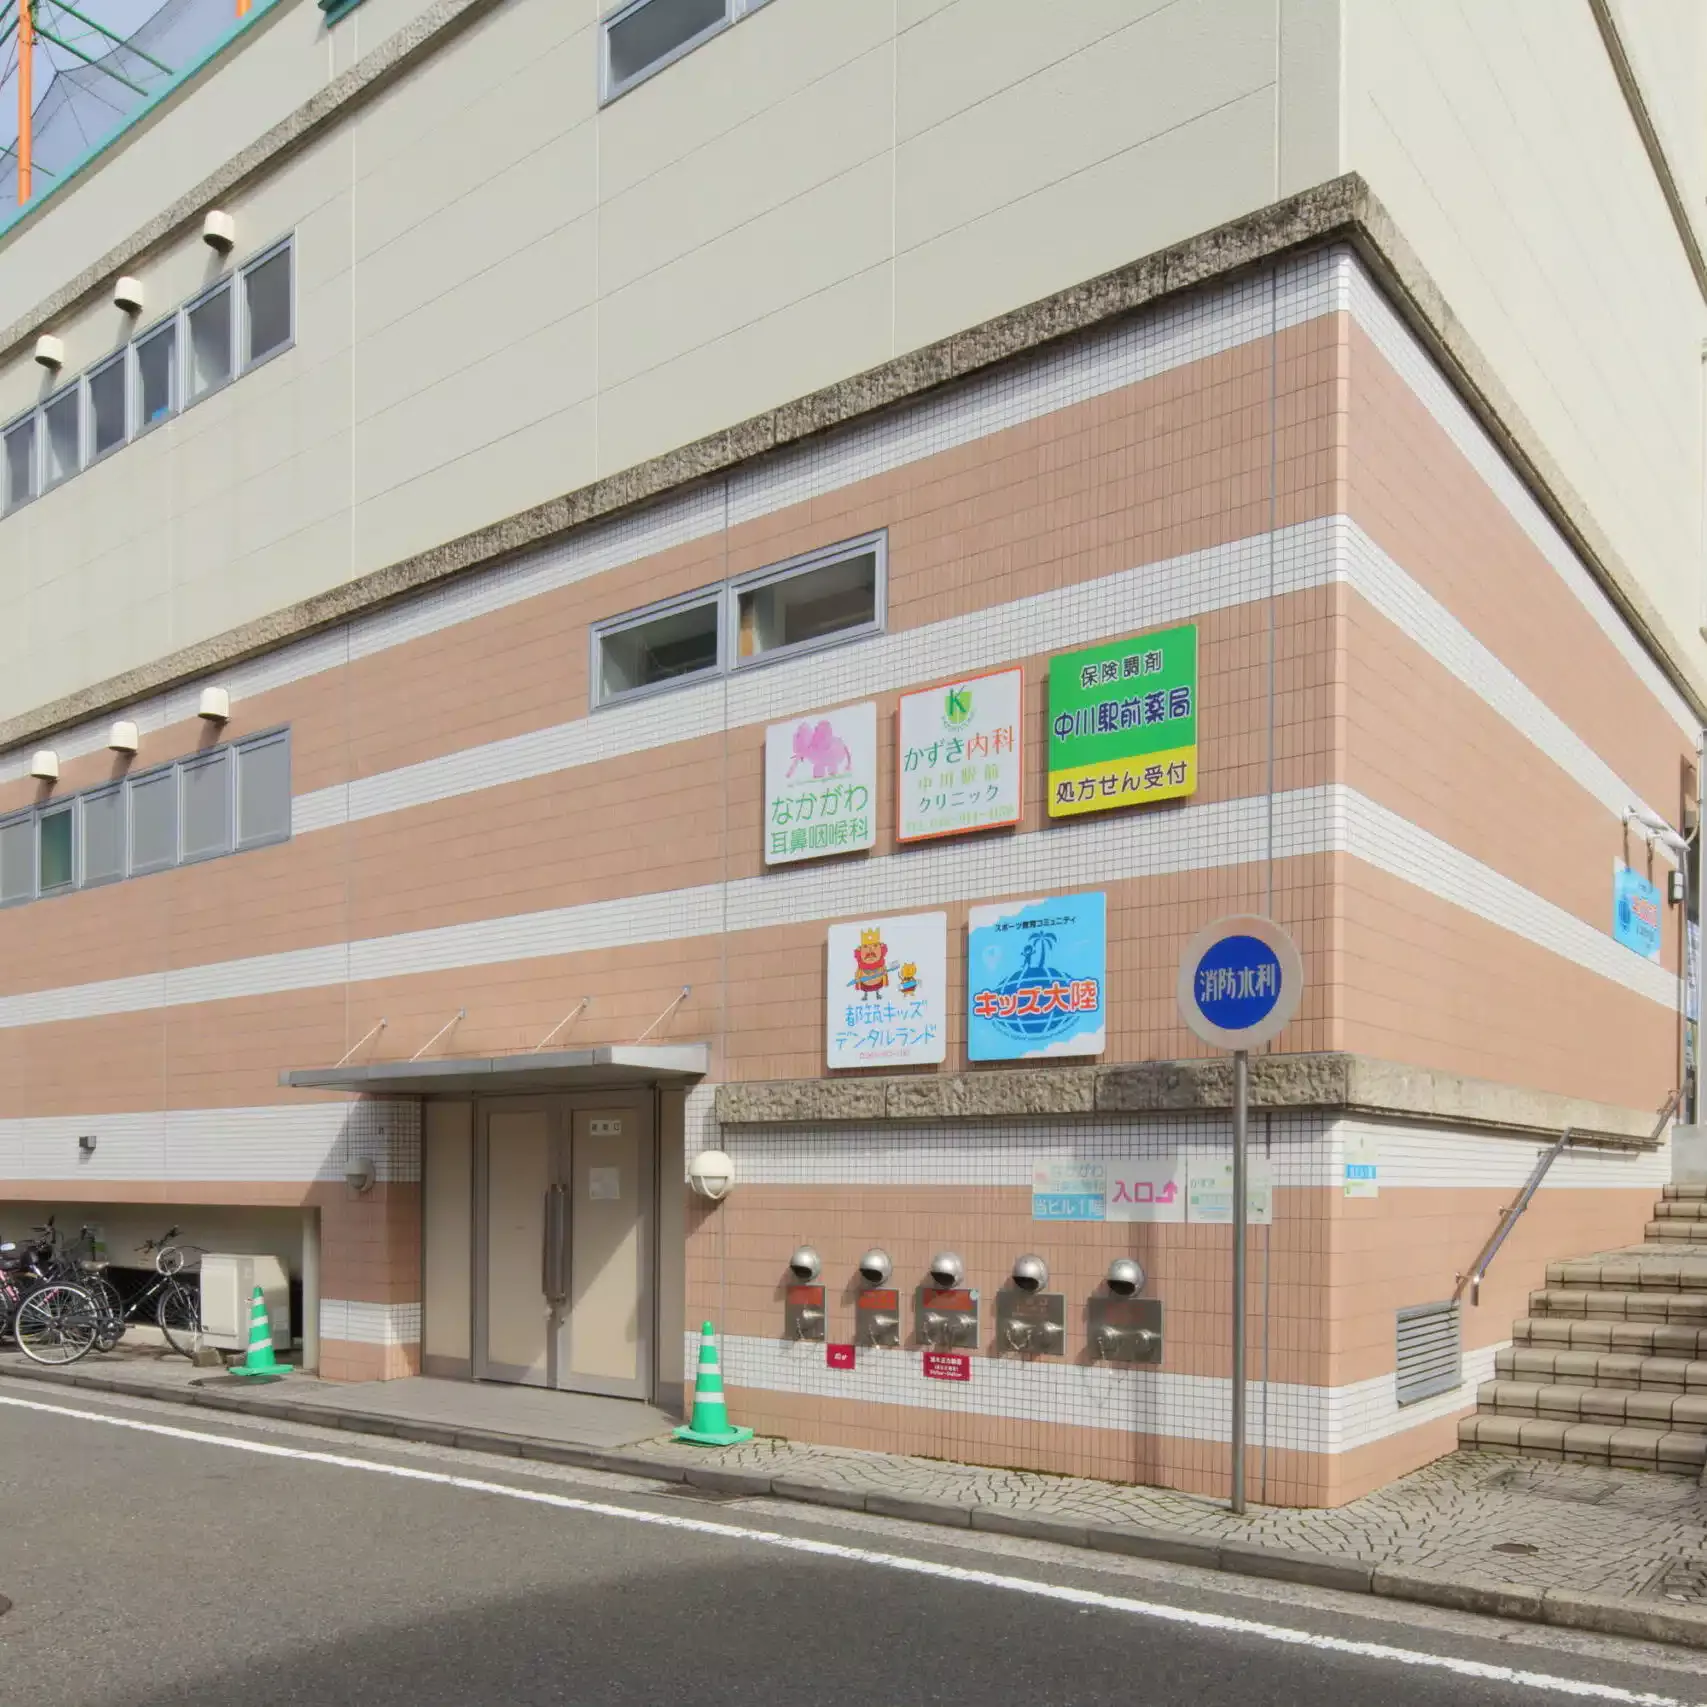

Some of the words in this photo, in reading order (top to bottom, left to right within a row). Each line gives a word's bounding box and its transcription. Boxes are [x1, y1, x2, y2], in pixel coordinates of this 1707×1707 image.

[1082, 651, 1163, 688] 保険調剤
[1054, 686, 1191, 741] 中川駅前薬局
[904, 725, 1014, 772] かずき内科
[919, 784, 999, 813] クリニック
[1056, 761, 1187, 804] 処方せん受付
[771, 783, 869, 825] なかがわ
[770, 816, 869, 855] 耳鼻咽喉科
[974, 979, 1098, 1018] キッズ大陸
[1200, 963, 1276, 1002] 消防水利
[844, 1000, 928, 1027] 都筑キッズ
[835, 1024, 937, 1051] デンタルランド
[1111, 1179, 1154, 1203] 入口
